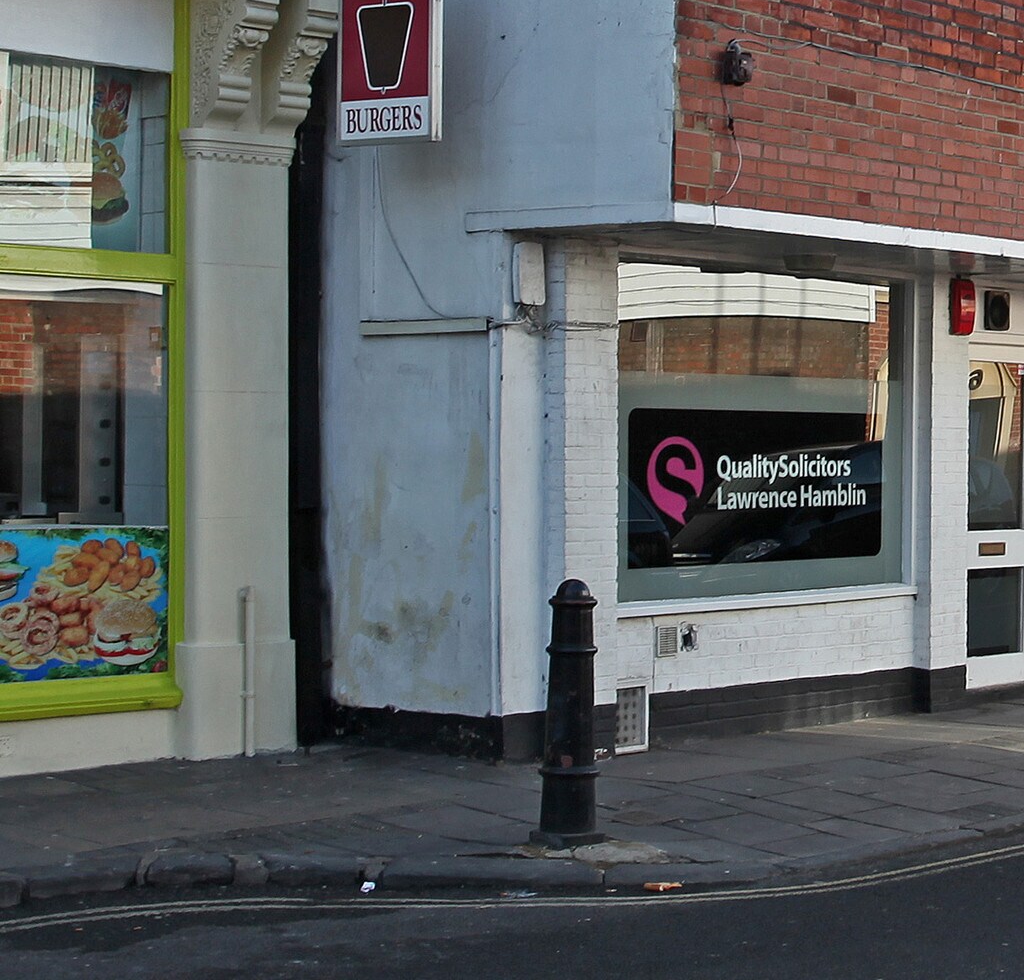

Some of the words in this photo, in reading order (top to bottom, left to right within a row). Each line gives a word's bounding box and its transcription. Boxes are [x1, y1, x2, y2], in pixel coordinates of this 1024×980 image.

[346, 105, 422, 134] BURGERS
[716, 453, 851, 485] QualitySolicitors
[717, 486, 797, 510] Lawrence
[800, 483, 866, 507] Hamblin
